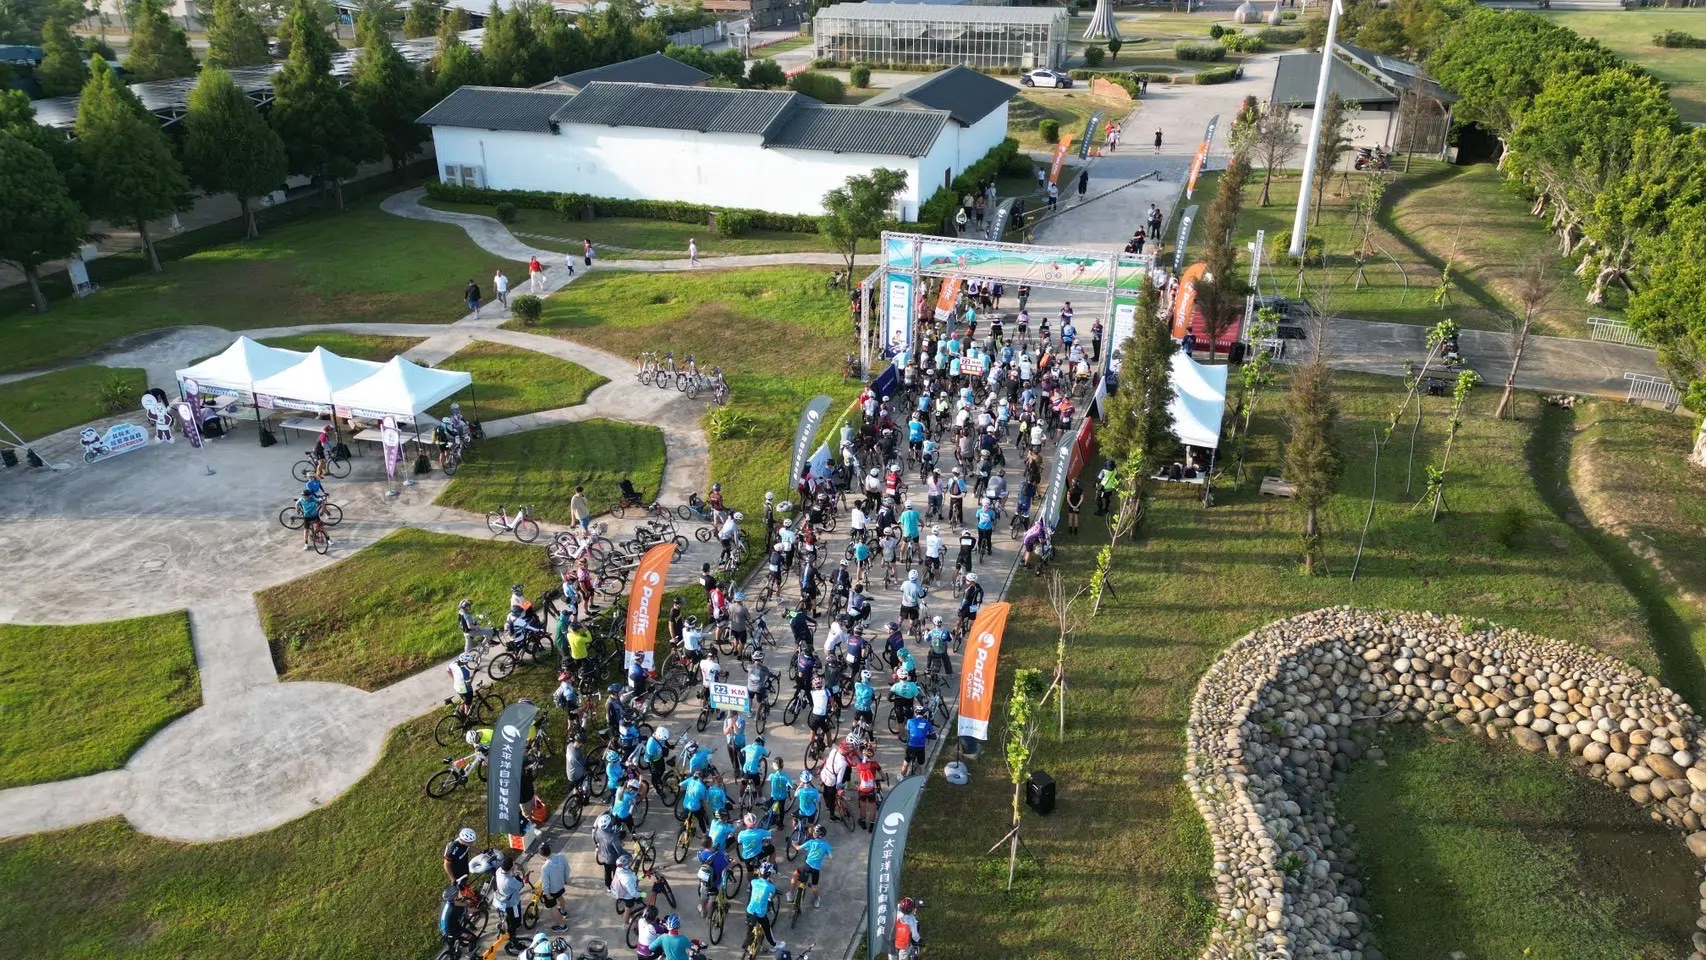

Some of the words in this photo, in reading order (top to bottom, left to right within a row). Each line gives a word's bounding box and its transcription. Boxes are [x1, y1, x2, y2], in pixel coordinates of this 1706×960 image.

[637, 586, 653, 635] Pacific
[714, 685, 727, 694] 22
[731, 688, 746, 696] KM
[966, 672, 974, 699] Cycles
[972, 648, 988, 702] Pacific
